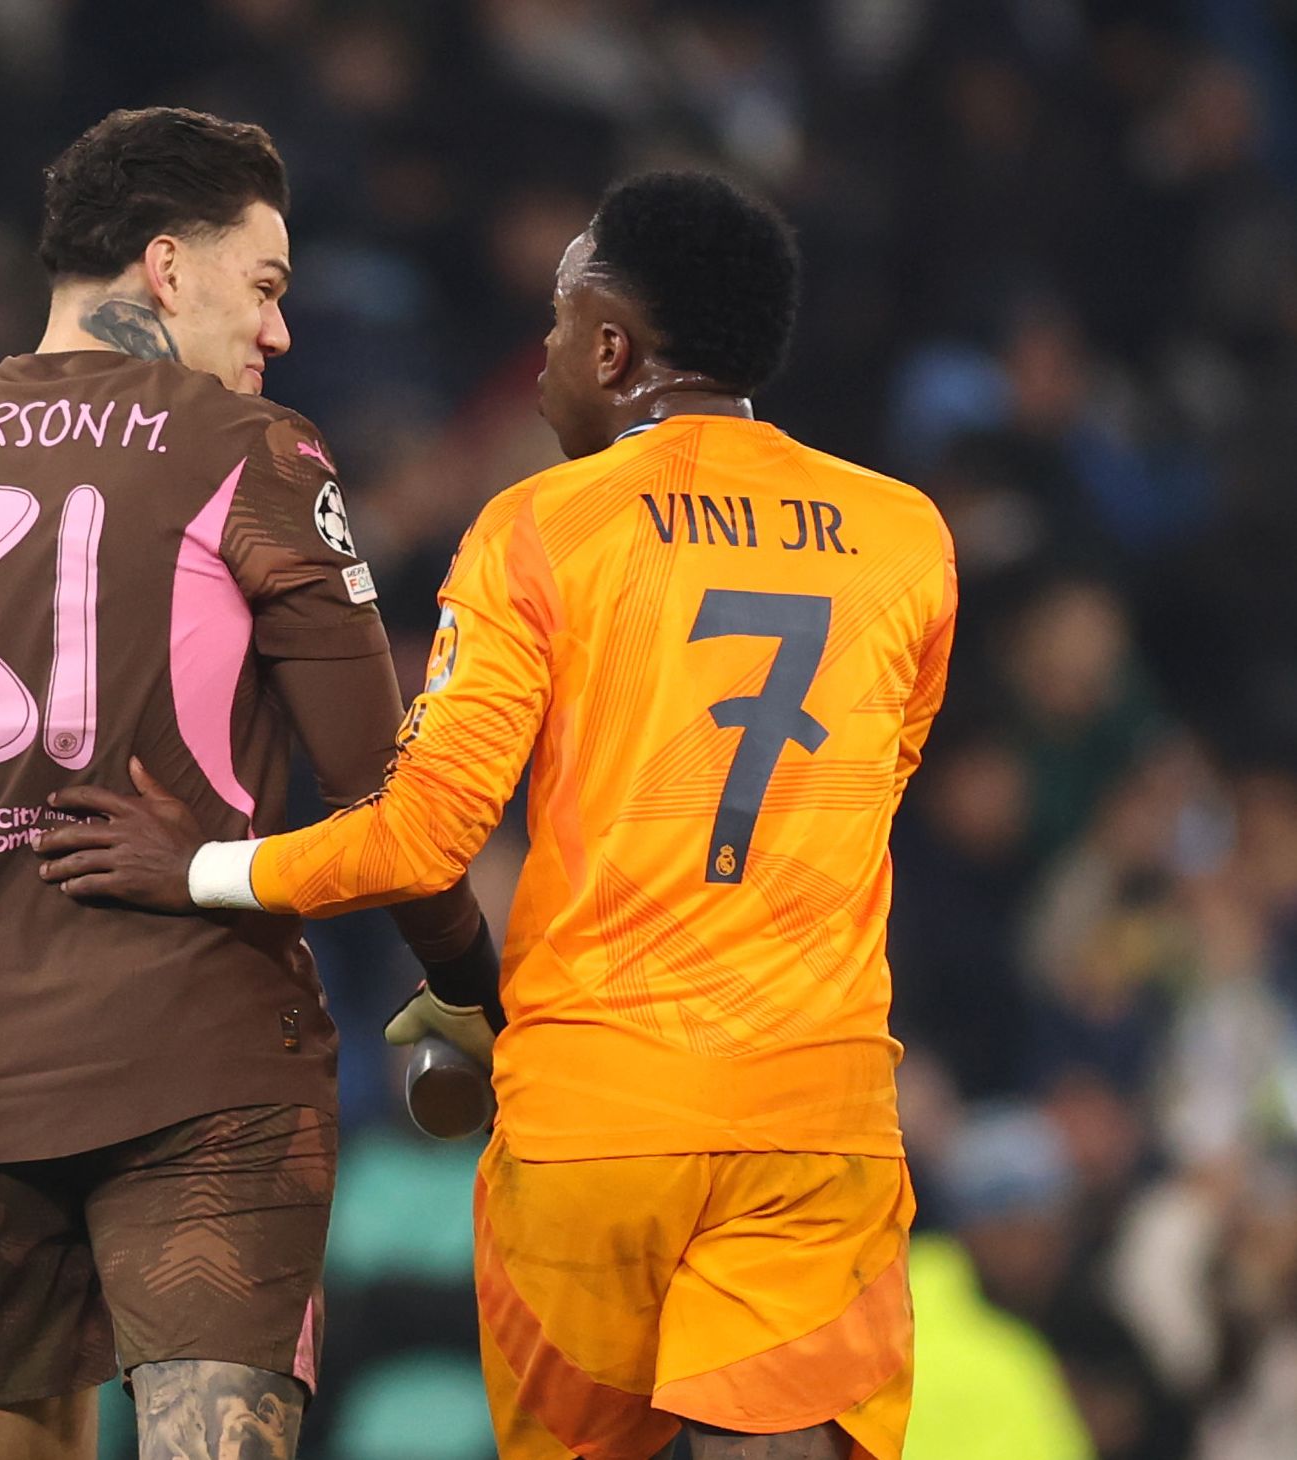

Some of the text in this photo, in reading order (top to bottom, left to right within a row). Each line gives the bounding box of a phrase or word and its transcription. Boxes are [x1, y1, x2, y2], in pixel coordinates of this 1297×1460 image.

[122, 408, 169, 453] M.
[640, 494, 859, 556] VINI JR.
[686, 589, 832, 883] 7
